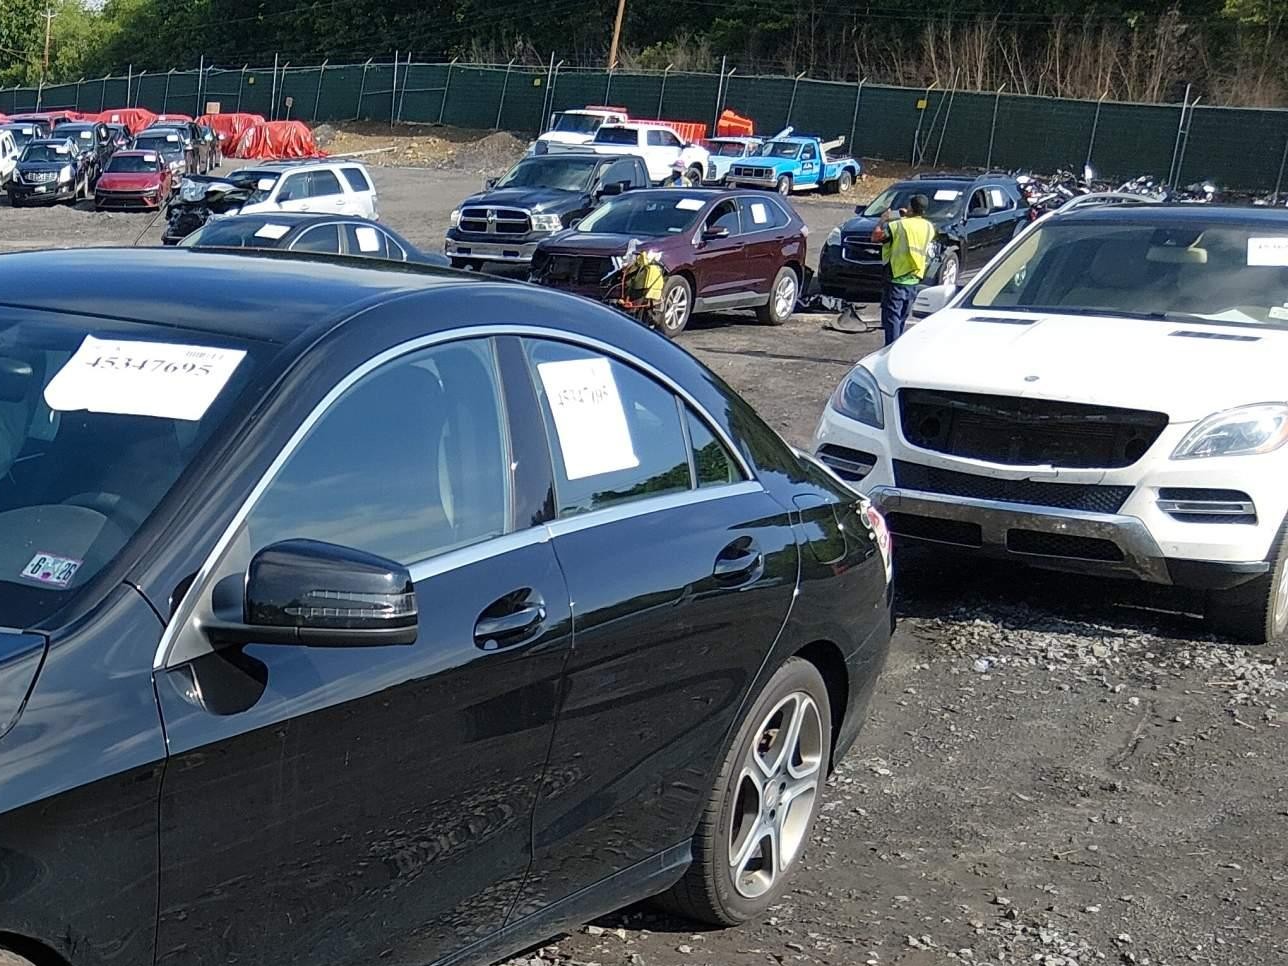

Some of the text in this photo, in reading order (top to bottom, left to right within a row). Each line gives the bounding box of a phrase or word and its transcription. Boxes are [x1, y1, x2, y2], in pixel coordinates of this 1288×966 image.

[84, 355, 215, 377] 45347695
[30, 556, 78, 581] 6 26
